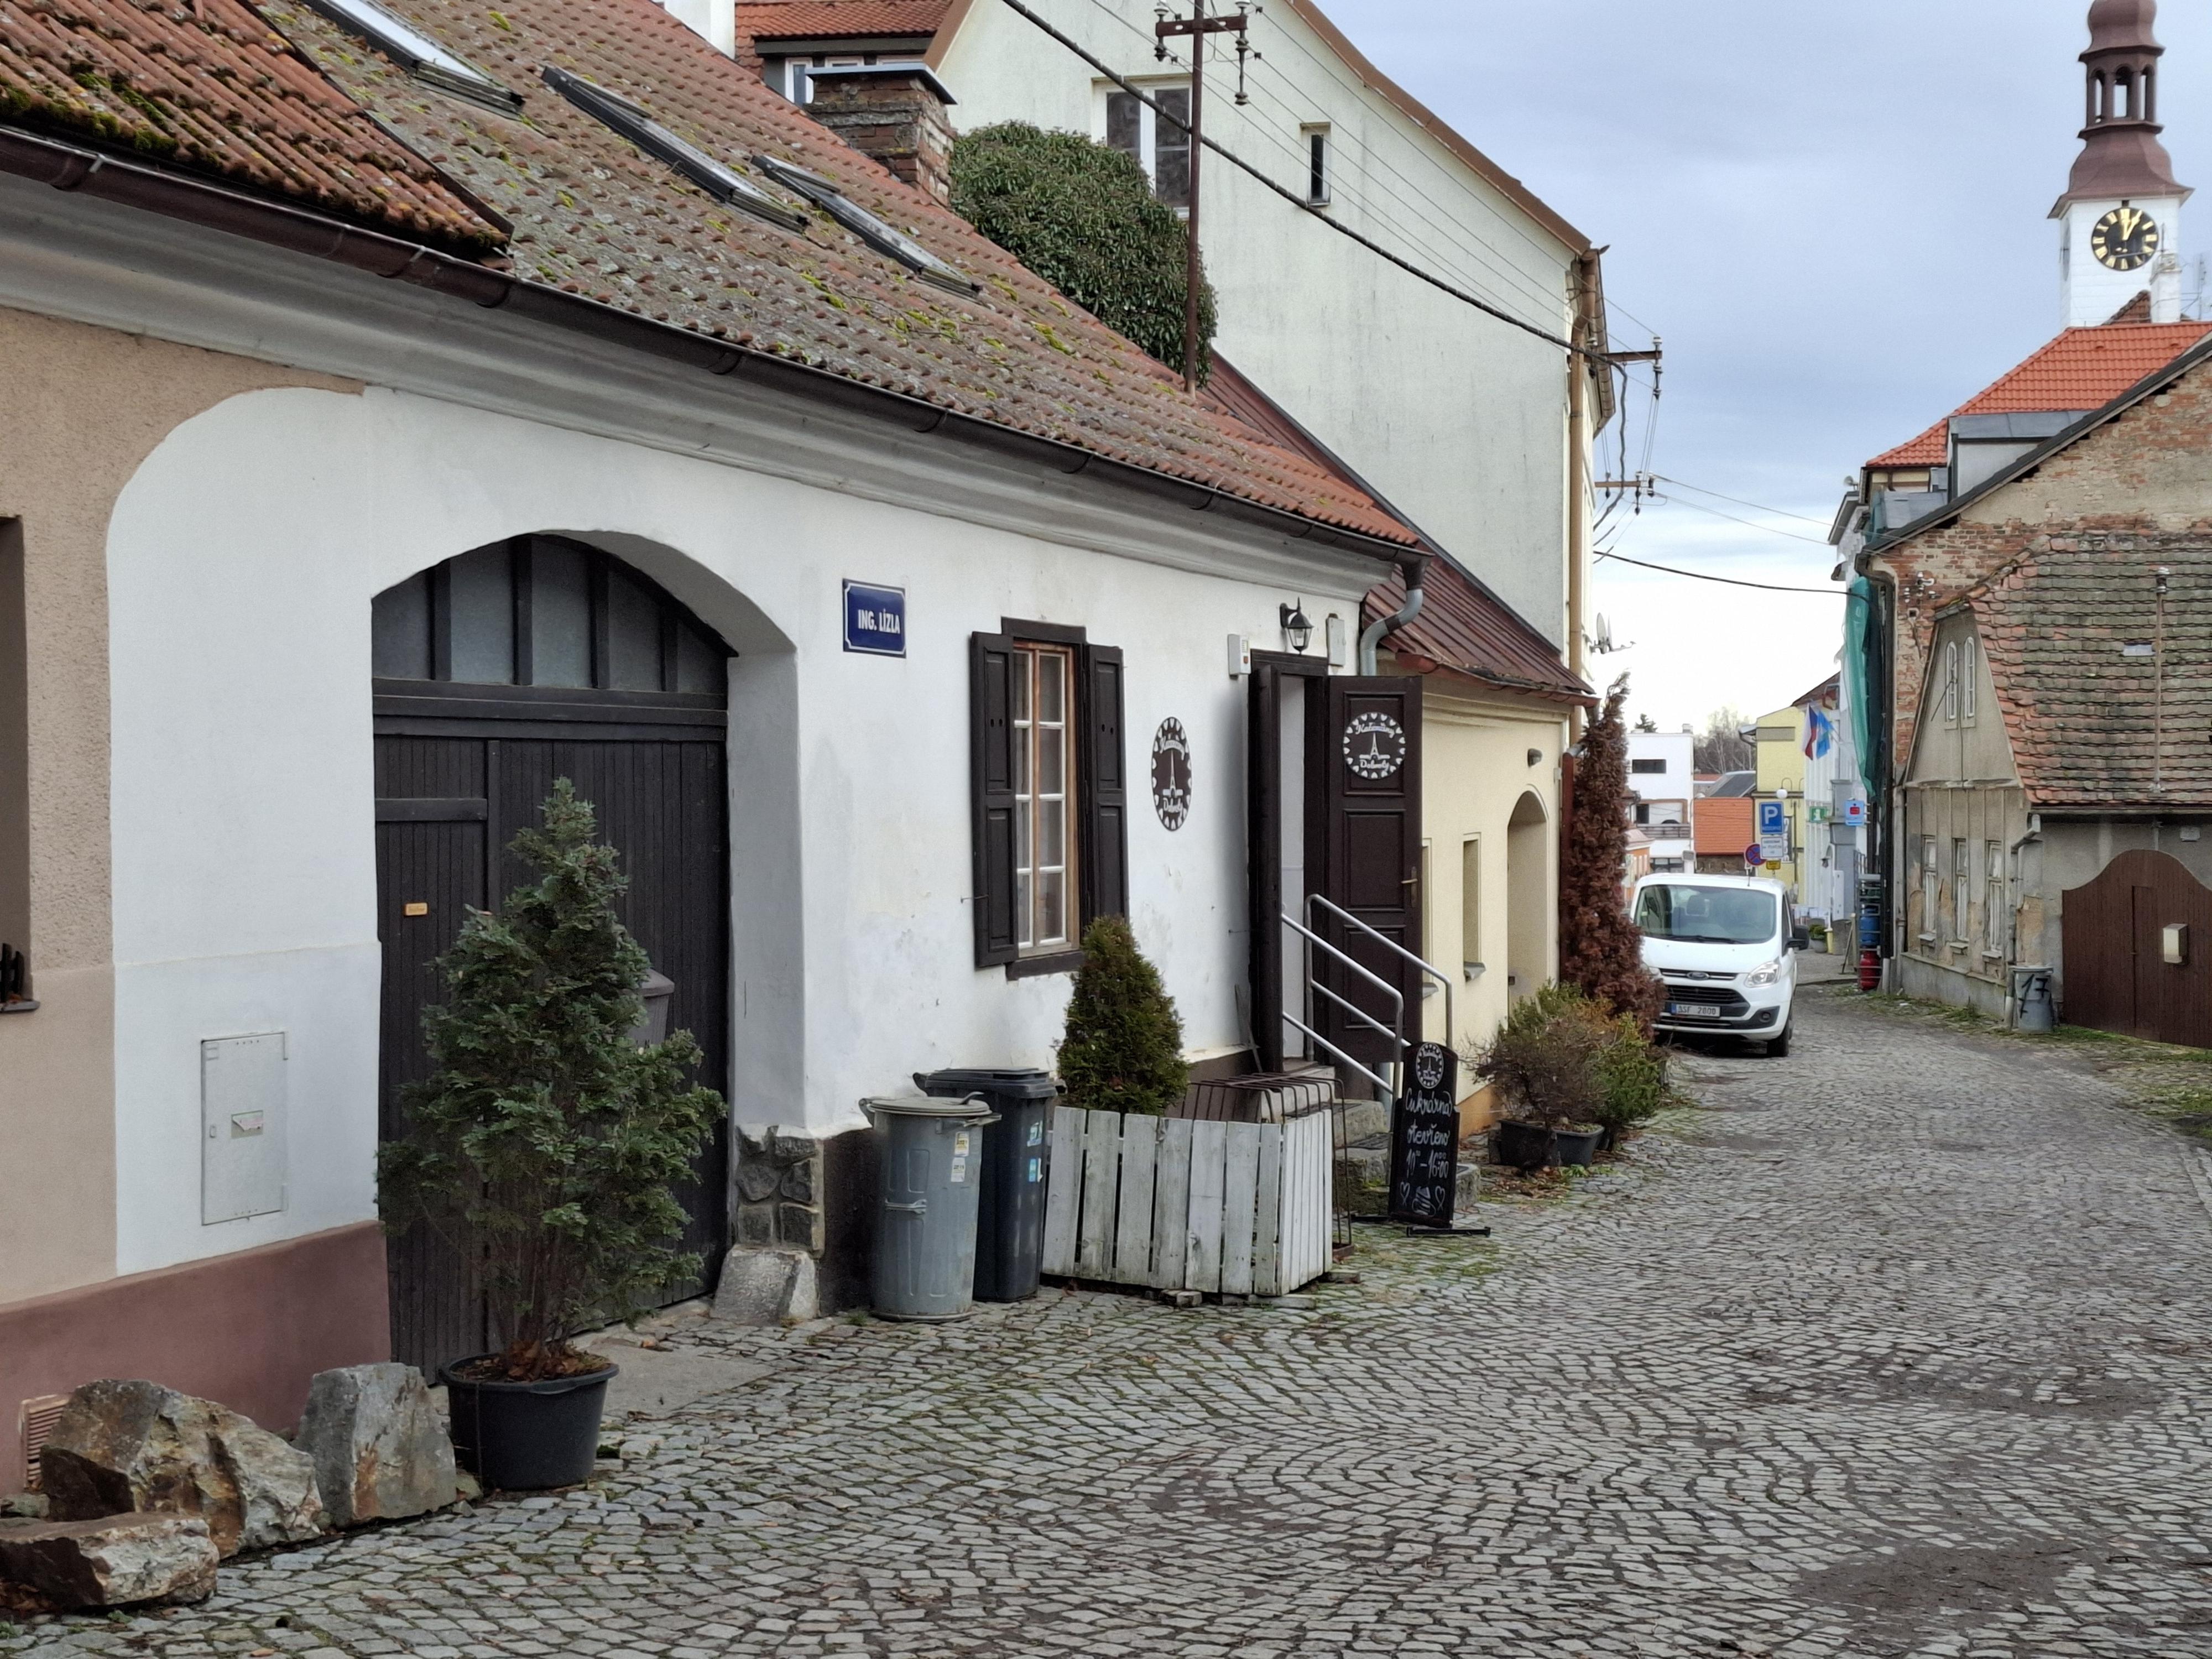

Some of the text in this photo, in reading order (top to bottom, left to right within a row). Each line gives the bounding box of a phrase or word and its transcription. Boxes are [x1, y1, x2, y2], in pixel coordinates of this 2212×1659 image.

[858, 609, 877, 630] ING.
[1765, 806, 1778, 825] P
[1406, 1087, 1453, 1117] Cukrárna
[1407, 1119, 1451, 1146] otevřeno
